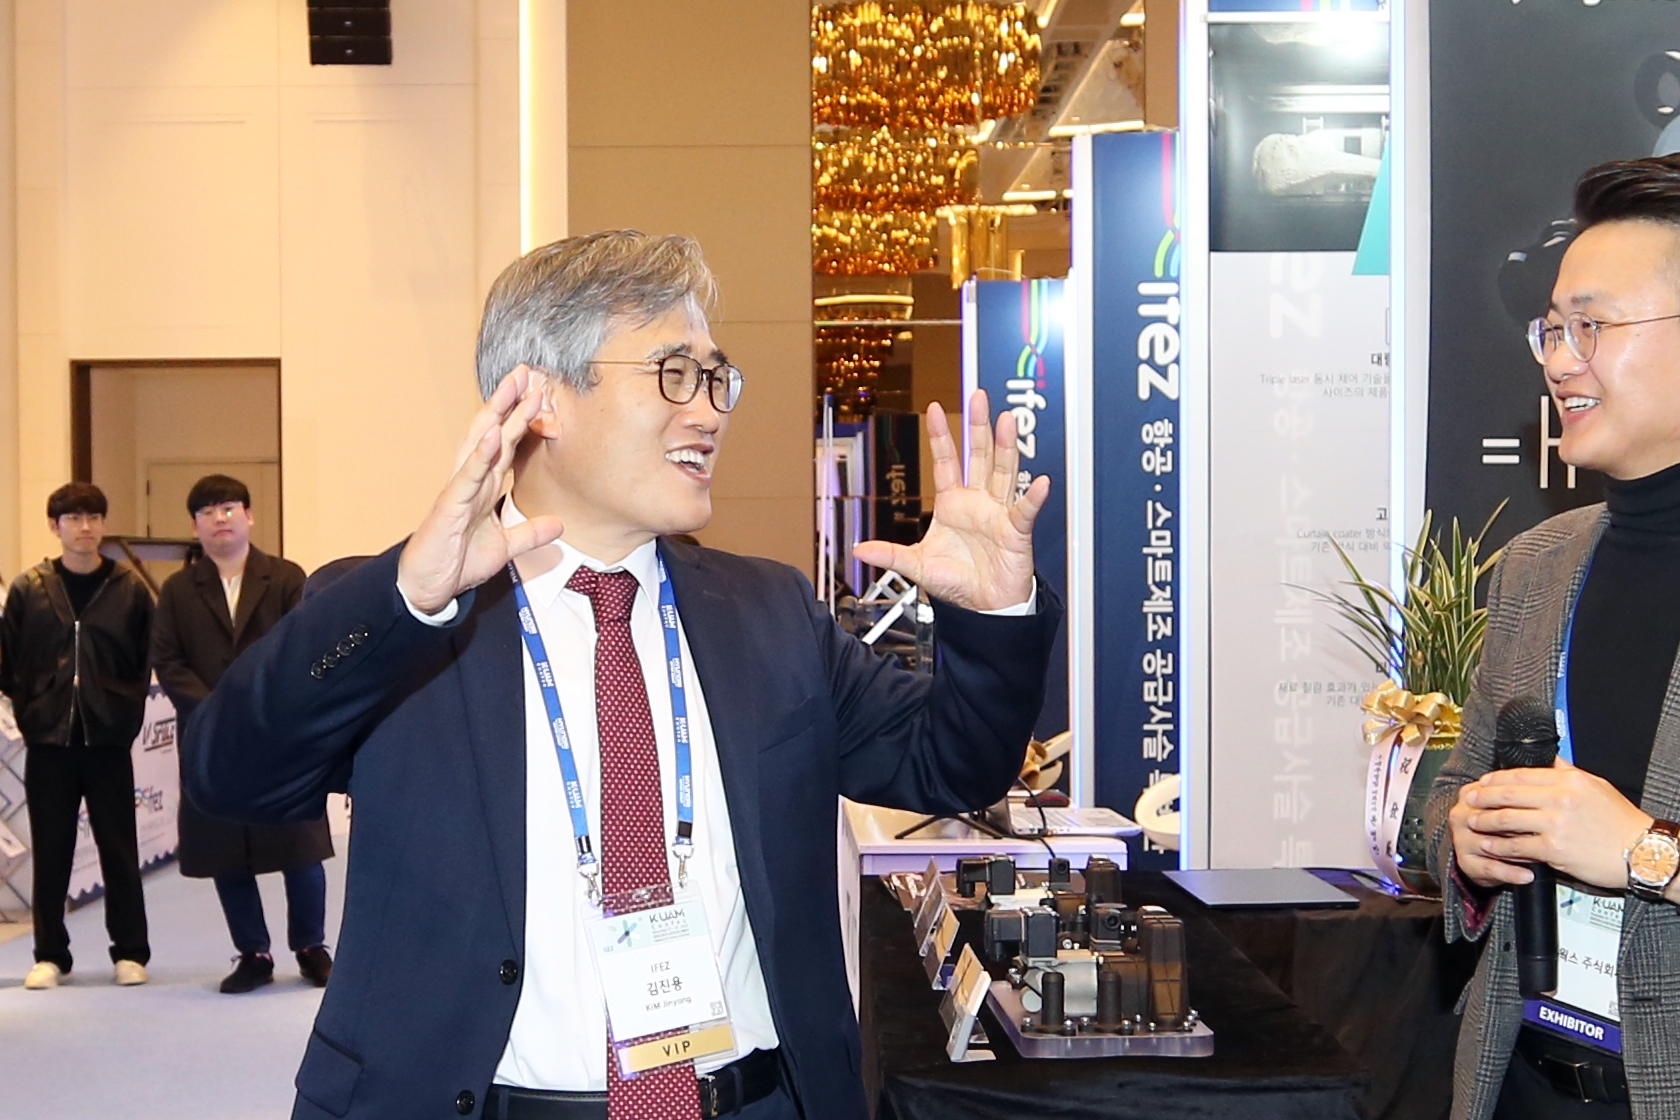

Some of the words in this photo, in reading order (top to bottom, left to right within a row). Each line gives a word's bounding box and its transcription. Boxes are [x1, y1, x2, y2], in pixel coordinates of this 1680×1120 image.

[1137, 281, 1180, 400] ifez
[1142, 649, 1175, 762] 공급사슬
[650, 961, 671, 974] IFEZ
[646, 976, 683, 996] 김진용
[1538, 1005, 1605, 1041] EXHIBITOR
[662, 1040, 691, 1057] VIP
